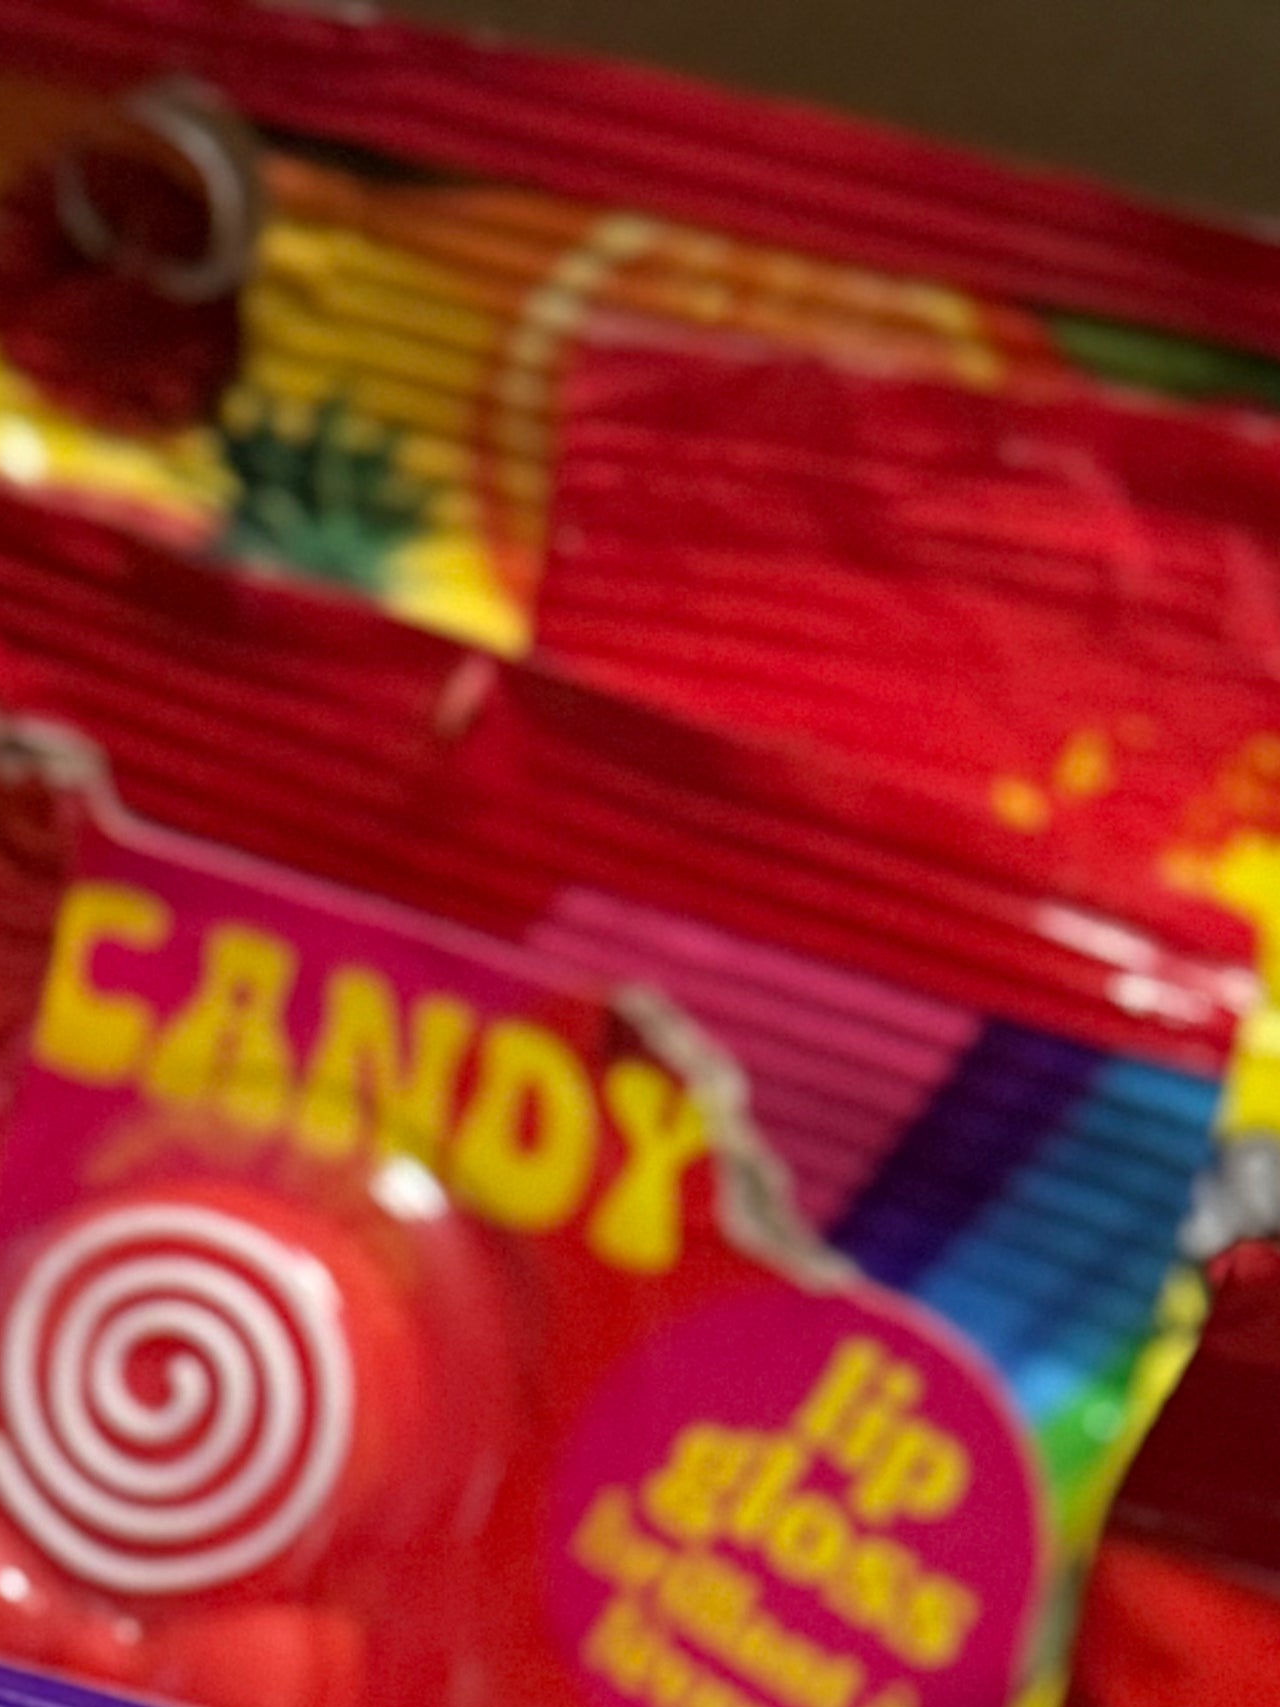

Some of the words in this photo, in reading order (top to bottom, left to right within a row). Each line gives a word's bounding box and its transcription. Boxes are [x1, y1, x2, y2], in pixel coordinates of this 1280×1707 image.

[32, 880, 712, 1276] CANDY
[645, 1423, 980, 1669] gloss
[797, 1335, 970, 1525] lip
